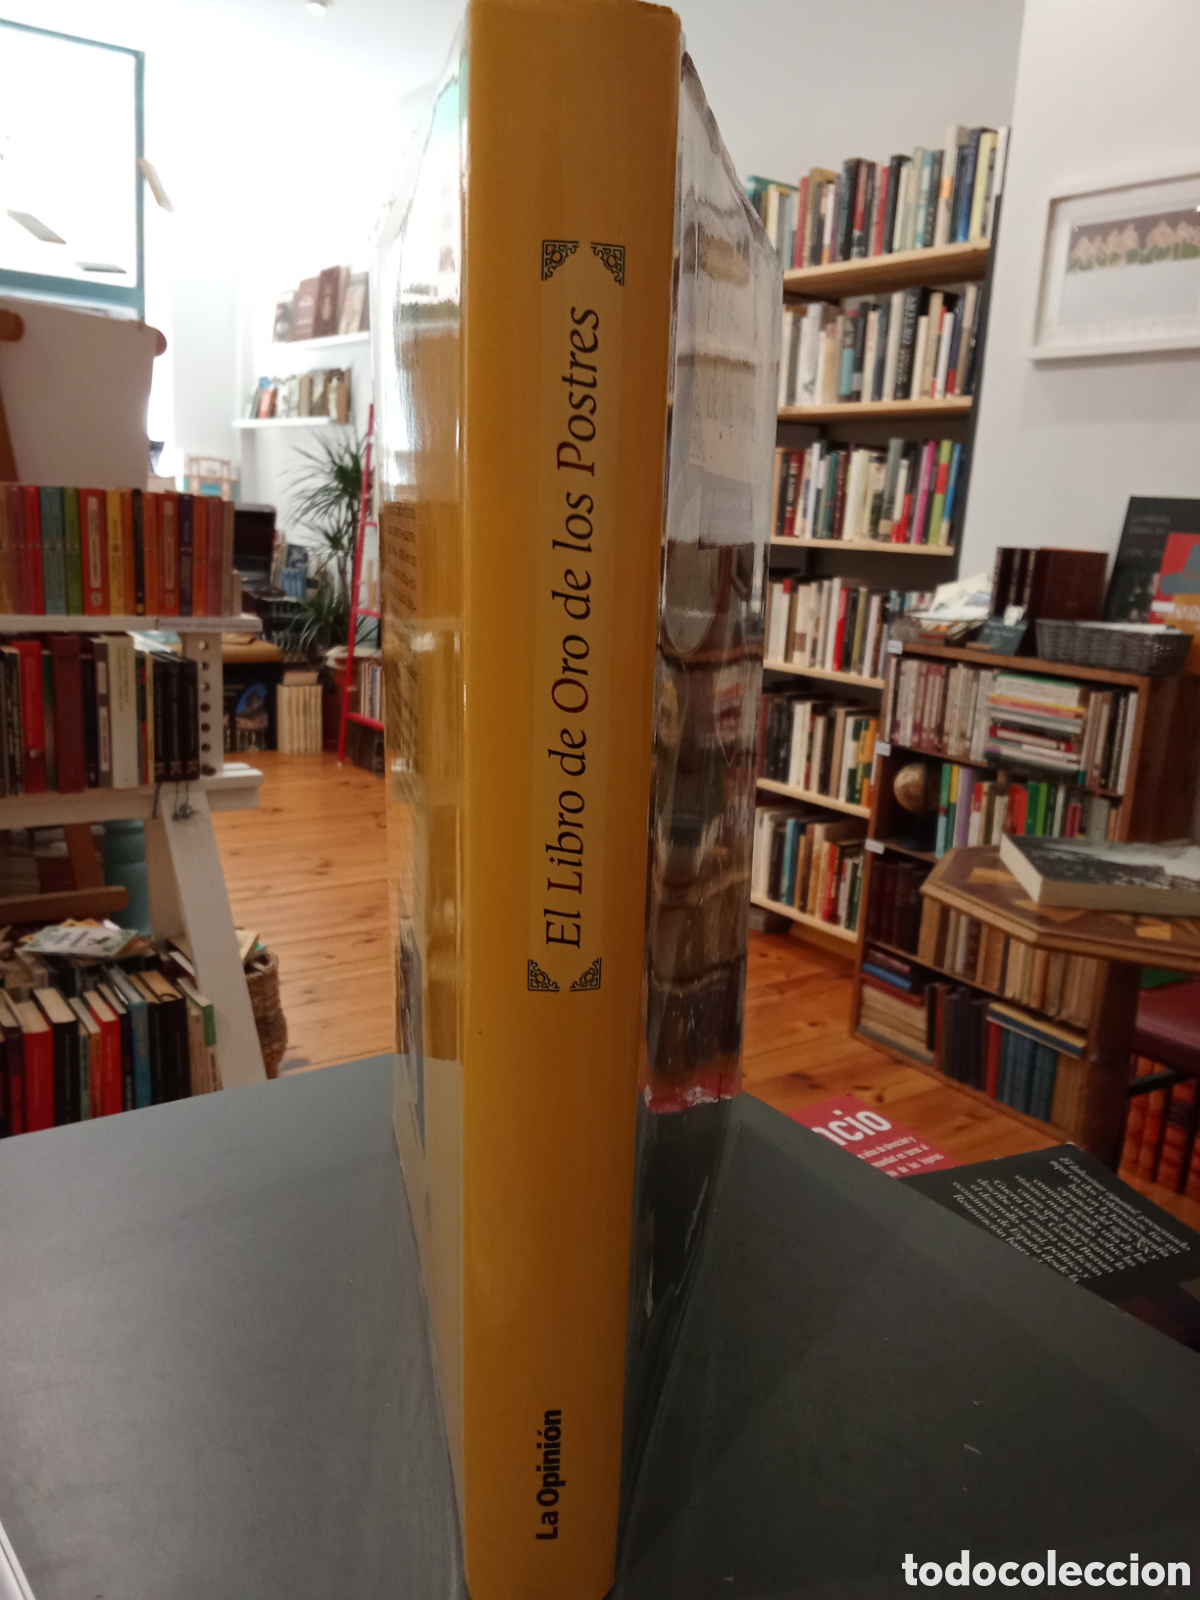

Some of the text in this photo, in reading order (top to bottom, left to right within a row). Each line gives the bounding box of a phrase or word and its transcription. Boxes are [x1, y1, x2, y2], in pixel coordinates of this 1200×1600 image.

[544, 304, 600, 949] El Libro de Oro de los Postres
[951, 1180, 998, 1218] económico
[1008, 1226, 1047, 1253] España
[1040, 1252, 1069, 1274] desde
[952, 1193, 1013, 1237] Restauración
[976, 1177, 1102, 1276] describe con amena erudición
[977, 1190, 1020, 1224] desarrollo
[1042, 1244, 1083, 1273] político
[992, 1179, 1023, 1204] Guerra
[1047, 1221, 1082, 1247] Gerald
[1078, 1245, 1114, 1273] Brenan
[1013, 1173, 1136, 1267] visiones más lúcidas sobre las
[1032, 1178, 1071, 1208] continúa
[1071, 1207, 1101, 1230] siendo
[1100, 1228, 1120, 1244] una
[1132, 1251, 1147, 1264] las
[1048, 1159, 1070, 1175] aquí
[1080, 1183, 1097, 1196] dos
[1147, 1230, 1165, 1242] fue
[1056, 1186, 1095, 1215] española
[1093, 1213, 1113, 1226] del
[1066, 1182, 1087, 1198] hito
[1042, 1208, 1059, 1222] que
[1058, 1221, 1115, 1262] propiciaron
[1136, 1214, 1191, 1251] presentado
[536, 1408, 566, 1540] La Opinión
